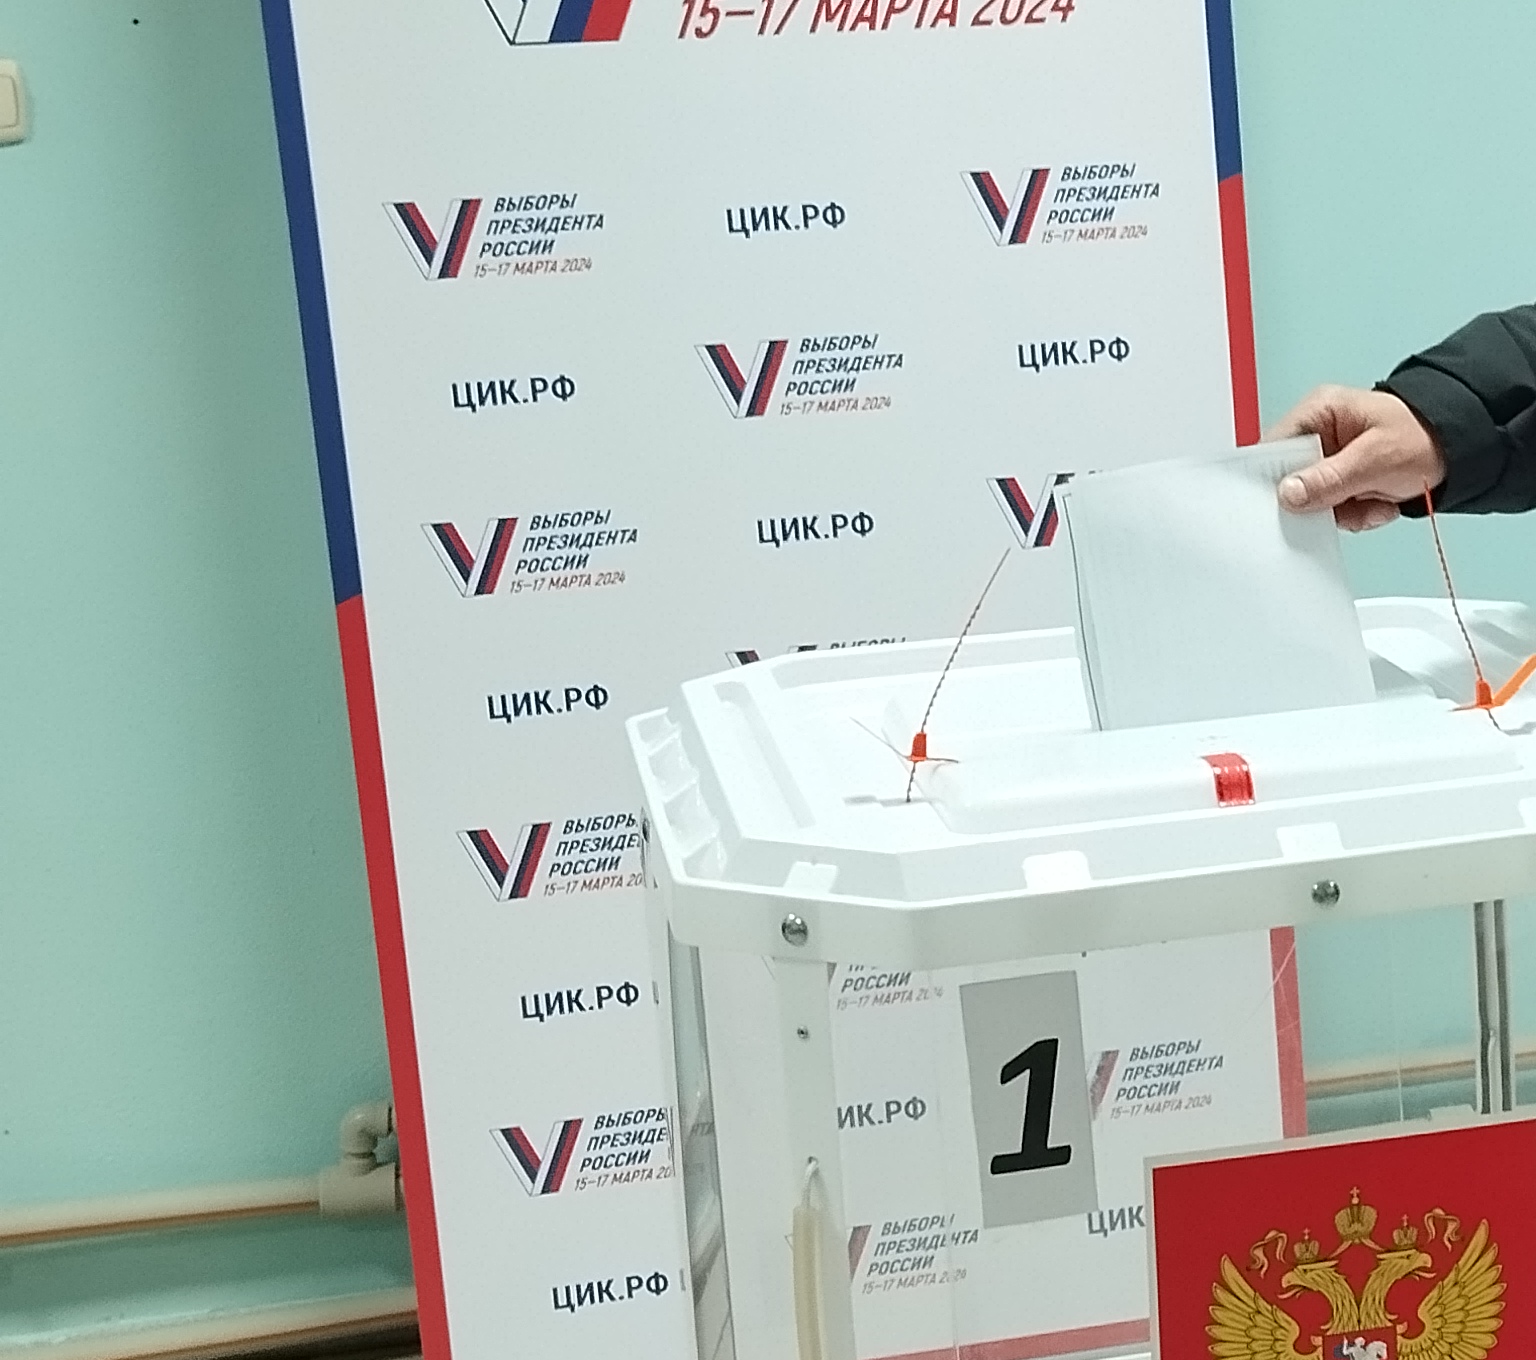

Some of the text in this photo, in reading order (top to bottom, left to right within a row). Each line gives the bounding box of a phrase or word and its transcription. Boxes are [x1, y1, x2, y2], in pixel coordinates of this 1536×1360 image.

[1060, 164, 1136, 182] ВЫБОРЫ
[494, 194, 578, 211] ВЫБОРЫ
[1053, 184, 1160, 202] ПРЕЗИДЕНТА
[487, 214, 604, 233] ПРЕЗИДЕНТА
[726, 202, 846, 238] ЦИК.РФ
[1046, 206, 1115, 223] РОССИИ
[1079, 226, 1117, 241] МАРТА
[1120, 225, 1148, 240] 2024
[479, 240, 554, 258] РОССИИ
[514, 259, 557, 276] МАРТА
[560, 258, 592, 273] 2024
[800, 335, 878, 353] ВЫБОРЫ
[791, 355, 904, 373] ПРЕЗИДЕНТА
[1018, 338, 1131, 373] ЦИК.РФ
[451, 375, 575, 412] ЦИК.РФ
[784, 378, 856, 396] РОССИИ
[817, 398, 858, 414] МАРТА
[860, 396, 892, 411] 2024
[529, 510, 610, 530] ВЫБОРЫ
[757, 512, 874, 548] ЦИК.РФ
[522, 529, 638, 550] ПРЕЗИДЕНТА
[514, 555, 589, 574] РОССИИ
[548, 576, 591, 593] МАРТА
[593, 572, 626, 588] 2024
[487, 685, 609, 722] ЦИК.РФ
[555, 834, 640, 856] ПРЕЗИДЕ
[548, 856, 621, 877] РОССИИ
[581, 877, 623, 895] МАРТА
[625, 873, 643, 889] 20
[841, 971, 911, 993] РОССИИ
[520, 981, 640, 1022] ЦИК.РФ
[1129, 1039, 1202, 1062] ВЫБОРЫ
[1122, 1055, 1224, 1082] ПРЕЗИДЕНТА
[1114, 1080, 1181, 1102] РОССИИ
[836, 1096, 927, 1130] ИК.РФ
[990, 1037, 1071, 1175] 1
[586, 1129, 667, 1152] ПРЕЗИДЕ
[579, 1150, 651, 1172] РОССИИ
[612, 1170, 652, 1187] МАРТА
[653, 1166, 672, 1183] 20
[866, 1254, 935, 1278] РОССИИ
[552, 1270, 669, 1314] ЦИК.РФ
